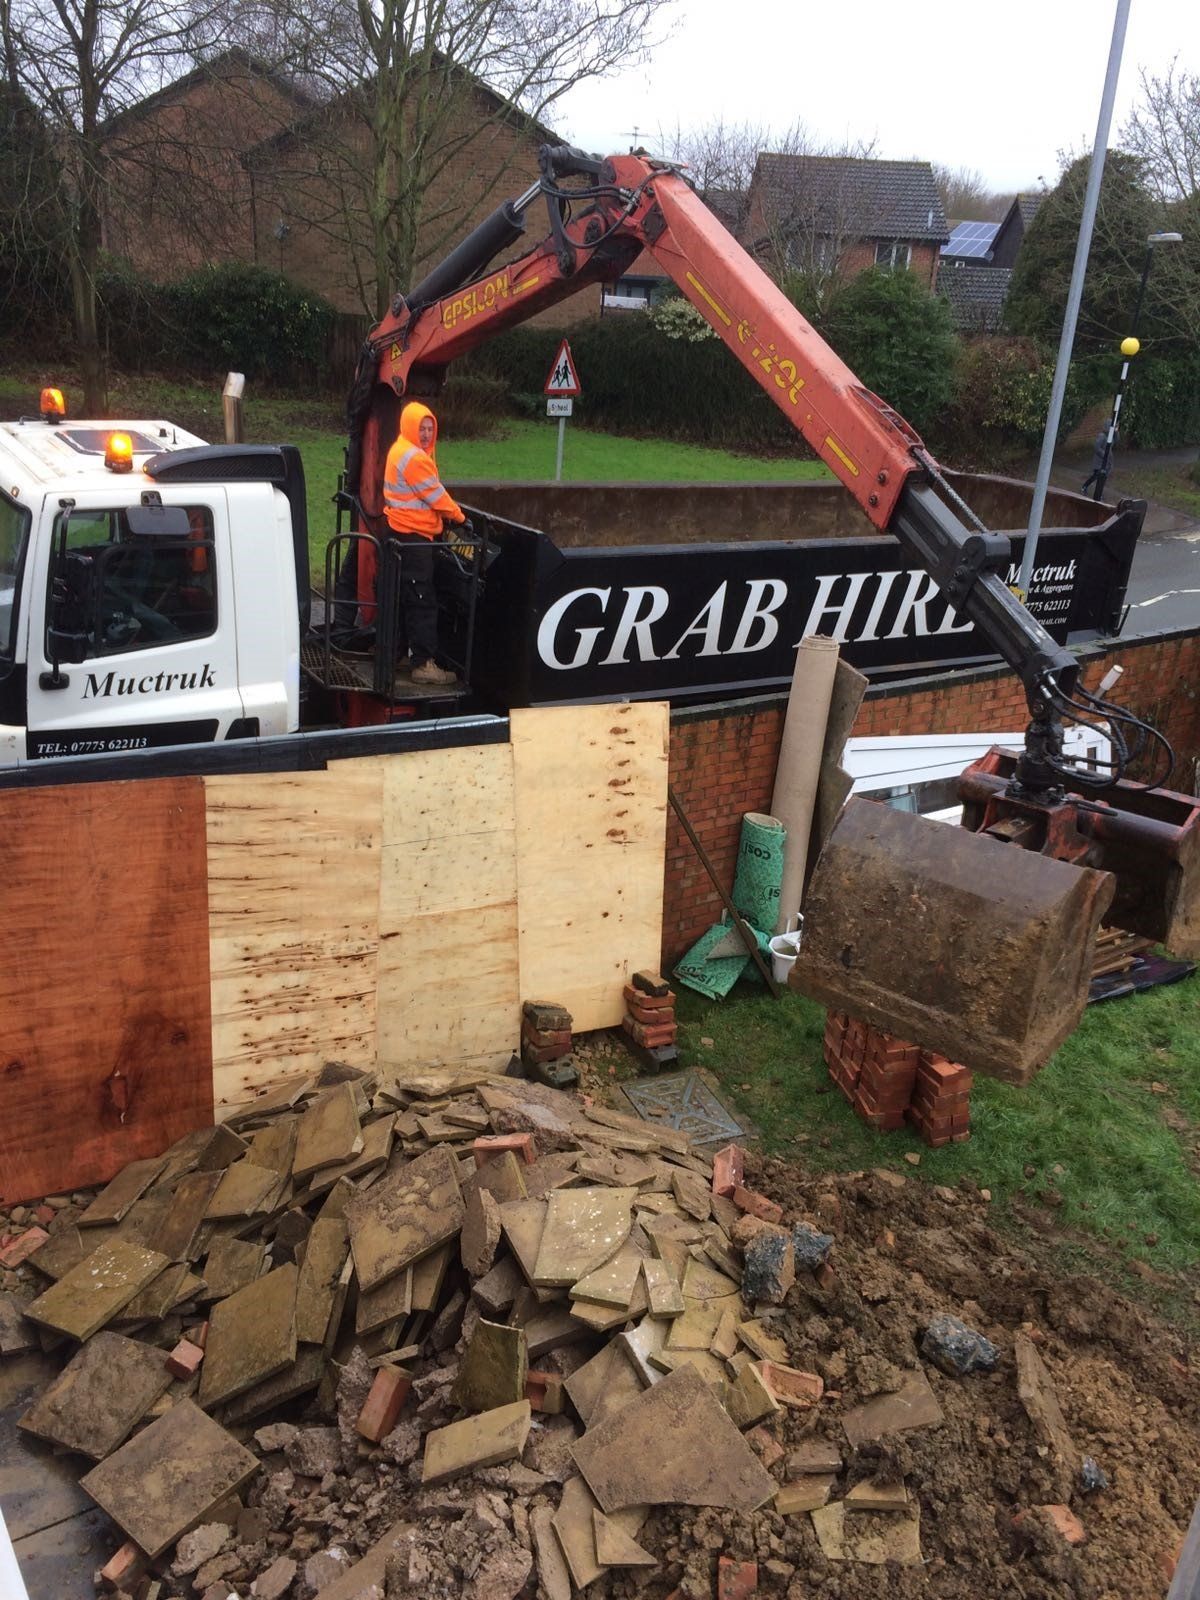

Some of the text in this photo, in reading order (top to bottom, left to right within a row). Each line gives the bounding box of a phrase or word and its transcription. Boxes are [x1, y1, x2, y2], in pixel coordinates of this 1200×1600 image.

[442, 273, 510, 330] EPSILON
[1004, 559, 1077, 585] Mctruk
[1033, 584, 1041, 593] &
[1041, 583, 1074, 594] Aggregates
[1043, 599, 1071, 611] 622113
[536, 578, 788, 671] GRAB
[81, 663, 216, 699] Muctruk
[37, 737, 148, 754] TEL: 07775 622113
